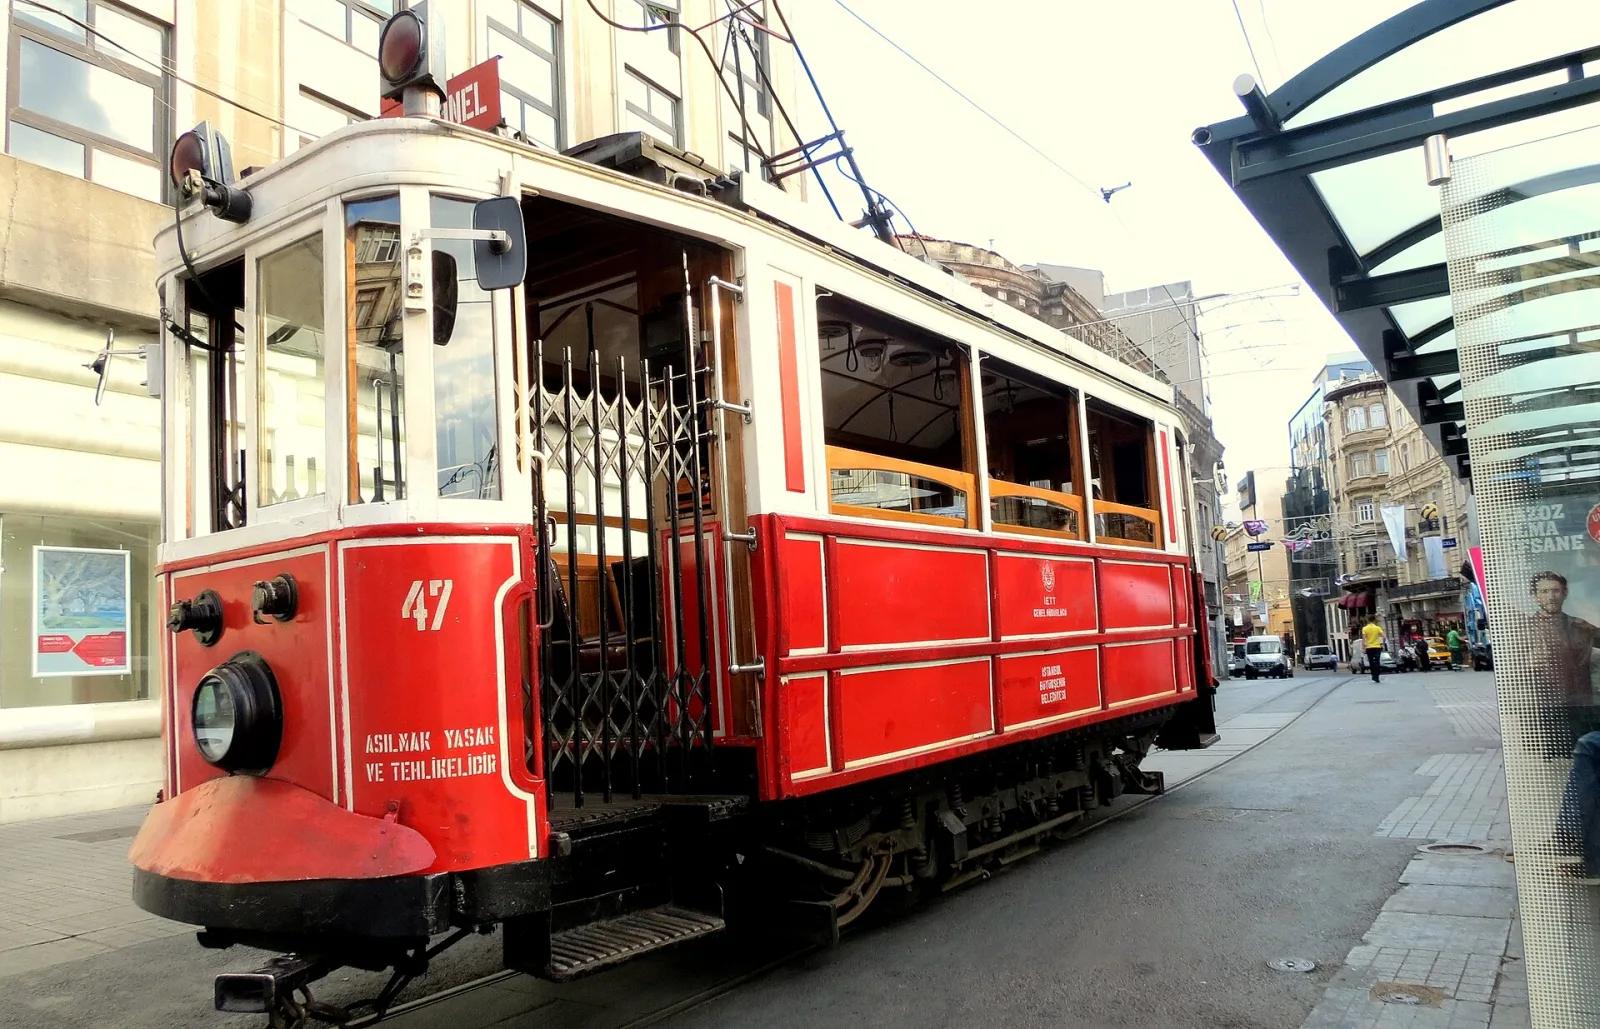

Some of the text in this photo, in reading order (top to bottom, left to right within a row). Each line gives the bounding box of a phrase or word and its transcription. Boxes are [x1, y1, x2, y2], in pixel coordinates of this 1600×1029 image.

[401, 579, 453, 632] 47
[365, 726, 495, 754] ASILMAK YASAK
[365, 752, 497, 783] VE TEHLİKELİDİR
